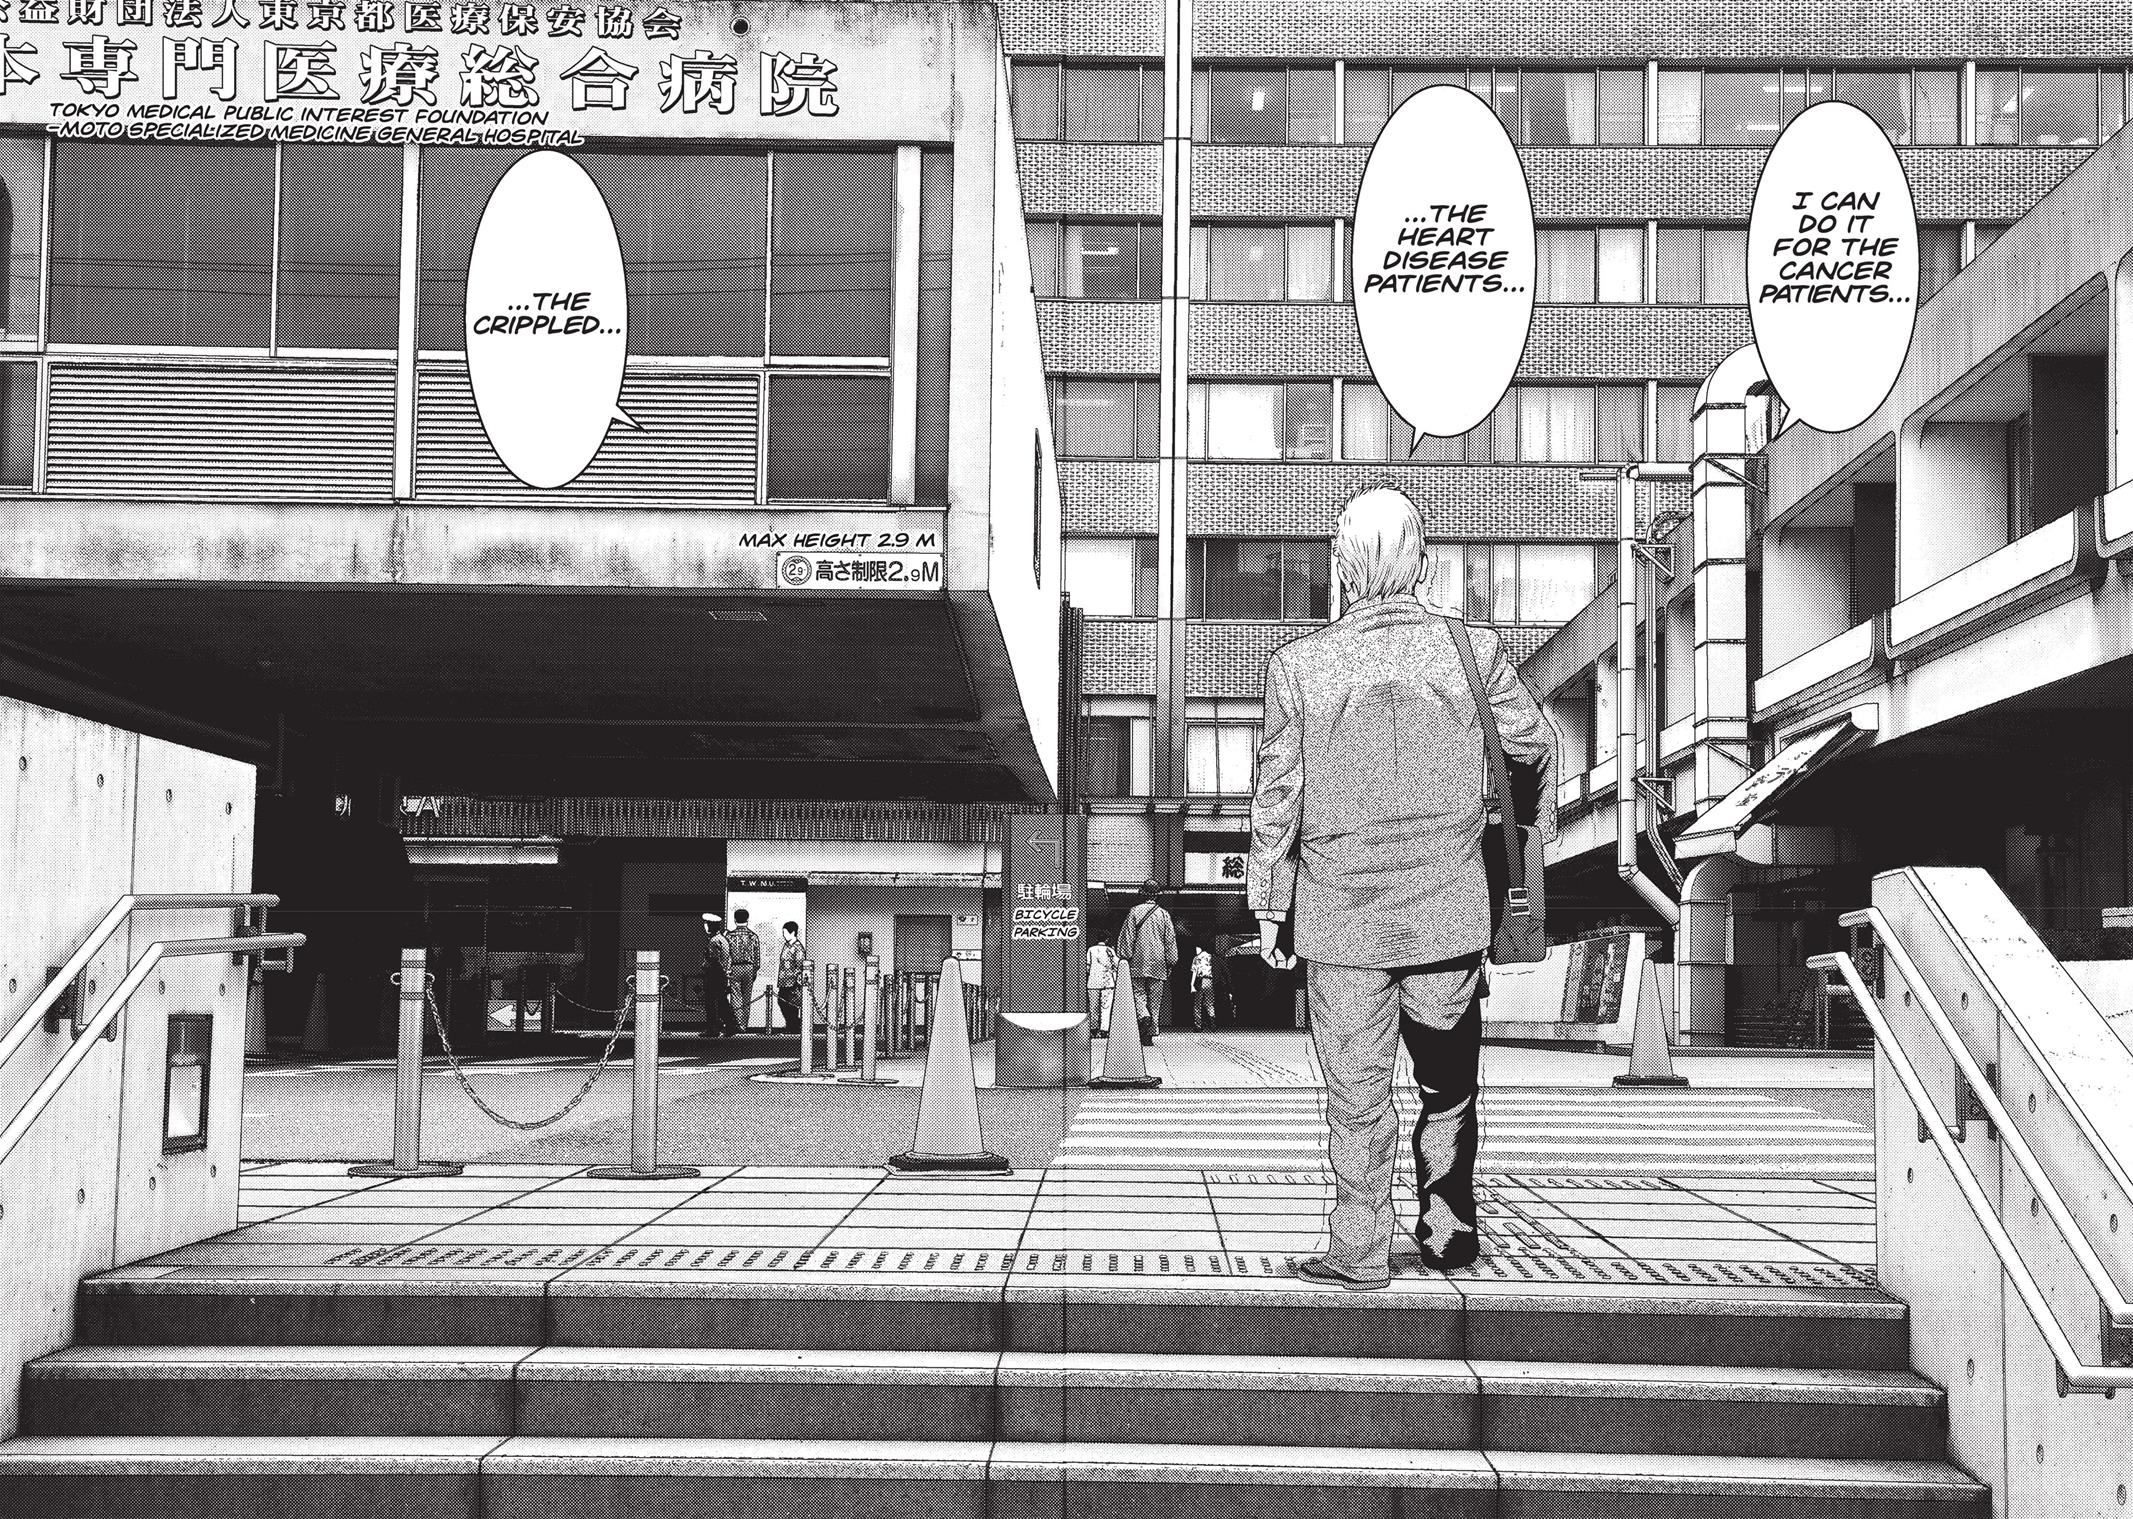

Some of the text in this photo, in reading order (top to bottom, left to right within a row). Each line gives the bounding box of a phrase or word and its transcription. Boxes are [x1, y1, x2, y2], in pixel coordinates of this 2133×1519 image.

[0, 0, 682, 40] 益財団法人東京都医療保安協会
[815, 559, 939, 582] 高さ制限2.9M
[1017, 883, 1072, 900] 駐輪場
